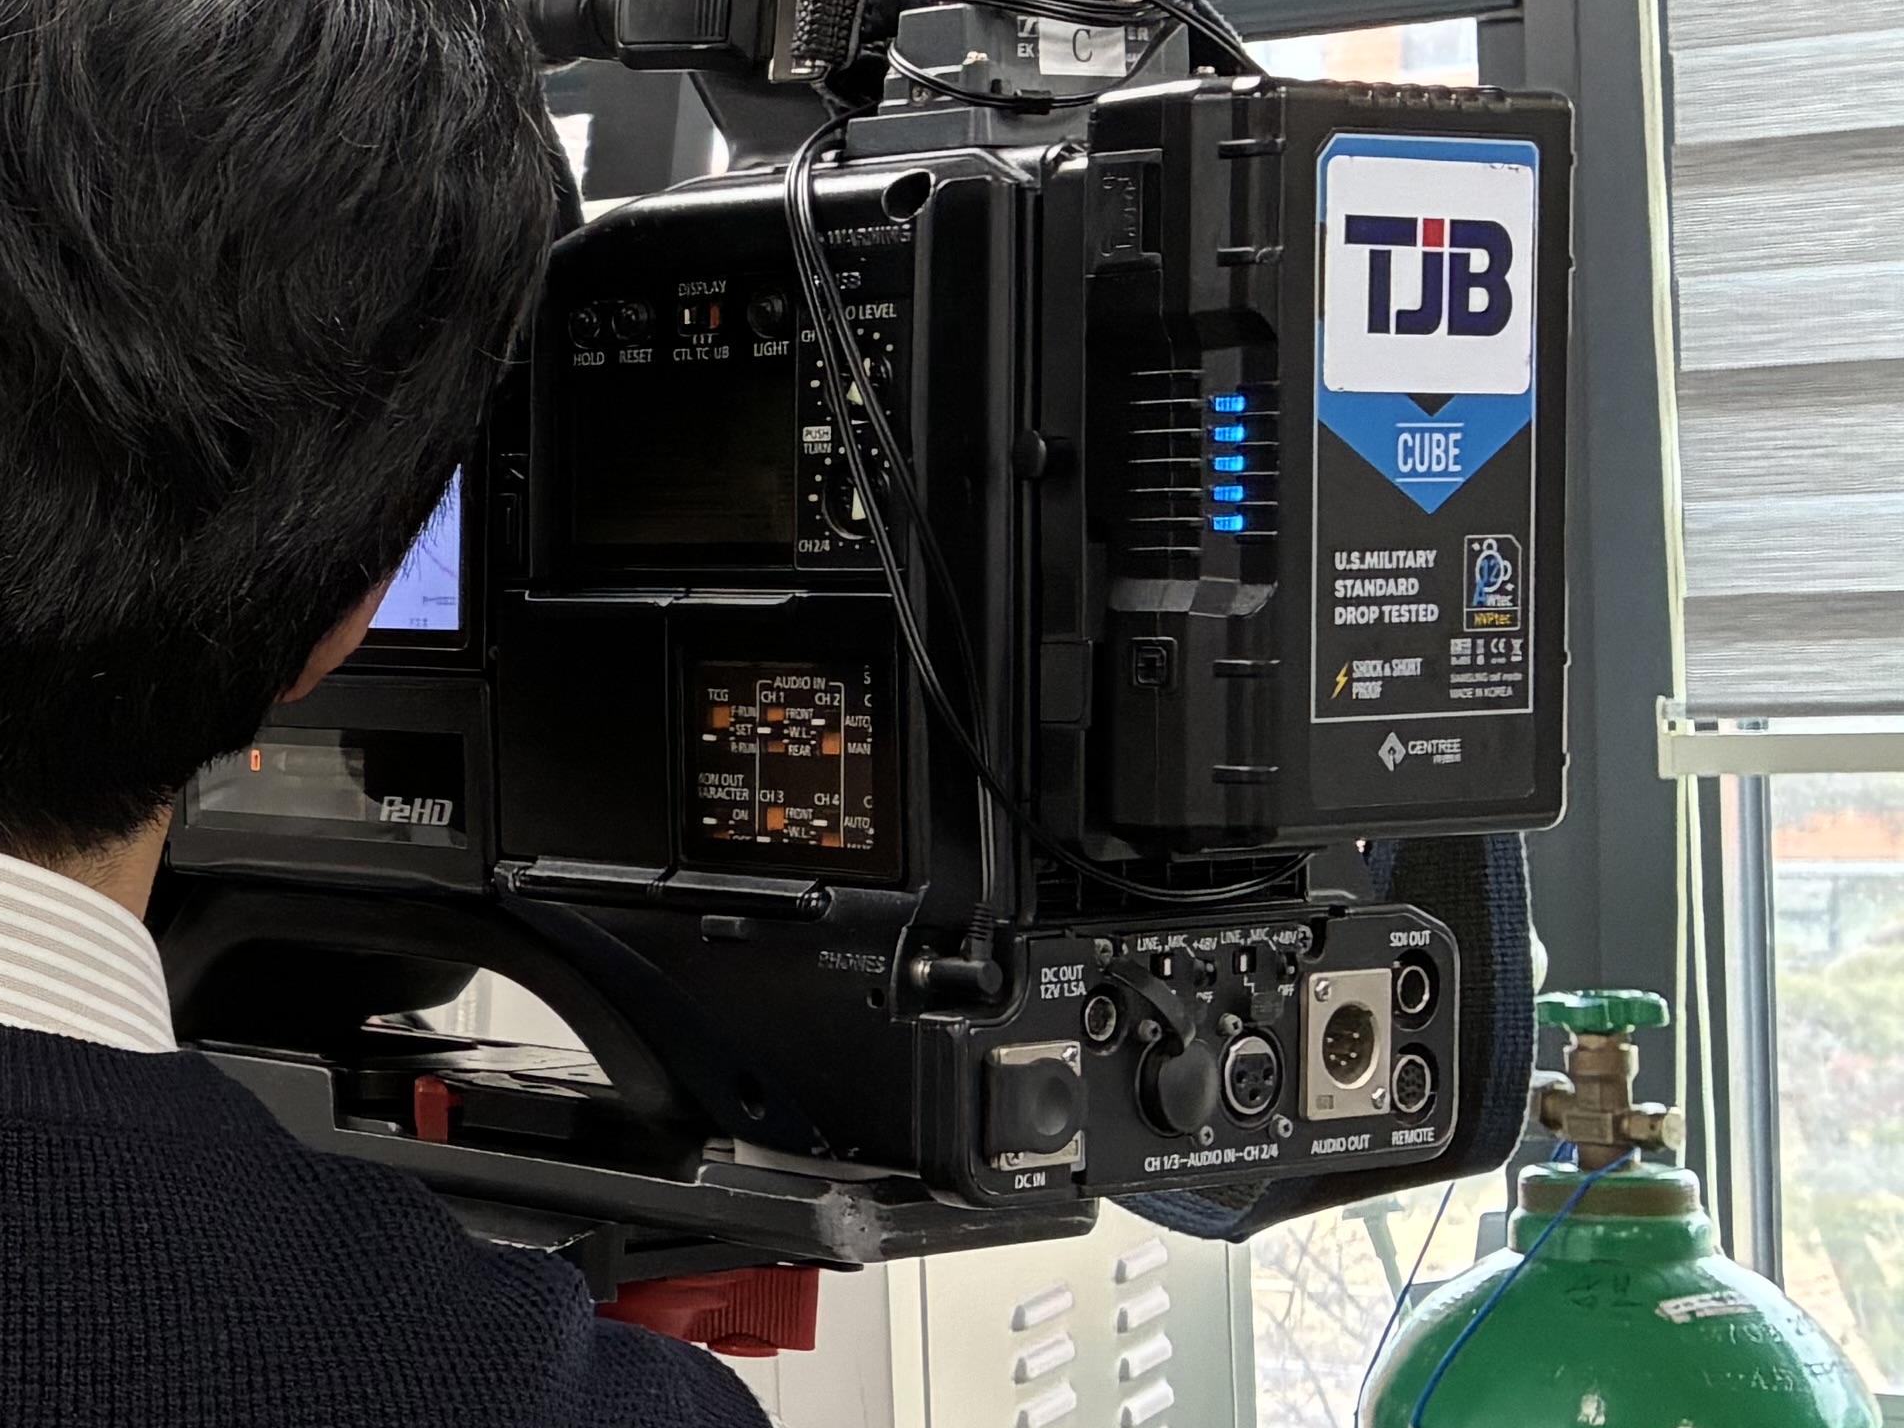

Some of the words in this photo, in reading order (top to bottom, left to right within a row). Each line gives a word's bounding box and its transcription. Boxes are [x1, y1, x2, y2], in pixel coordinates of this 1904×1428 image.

[1072, 28, 1093, 62] C
[1344, 213, 1513, 337] TJB
[678, 280, 727, 297] DISPLAY
[858, 303, 897, 320] LEVEL
[619, 348, 653, 363] RESET
[673, 348, 693, 362] CTL
[696, 347, 710, 361] TC
[714, 345, 730, 360] UB
[753, 341, 790, 357] LIGHT
[573, 352, 605, 366] HOLD
[804, 428, 830, 440] PUSH
[1397, 432, 1463, 473] CUBE
[798, 541, 813, 553] CH
[1334, 549, 1438, 571] U.S.MILITARY
[1334, 578, 1420, 599] STANDARD
[1334, 606, 1380, 625] DROP
[1382, 603, 1440, 624] TESTED
[773, 676, 811, 689] AUDIO
[813, 677, 826, 690] IN
[707, 688, 729, 702] TCG
[760, 691, 776, 704] CH
[778, 691, 785, 703] 1
[1484, 685, 1514, 698] KOREA
[814, 693, 830, 706] CH
[832, 693, 840, 706] 2
[786, 708, 814, 720] FRONT
[844, 715, 871, 727] AUTO
[735, 724, 753, 736] SET
[788, 744, 812, 757] REAR
[721, 774, 745, 787] OUT
[759, 790, 775, 804] CH
[777, 790, 785, 804] 3
[814, 793, 829, 806] CH
[832, 793, 840, 806] 4
[732, 809, 749, 821] ON
[785, 808, 813, 820] FRONT
[844, 816, 871, 829] AUTO
[1390, 931, 1408, 947] SDI
[1409, 930, 1432, 946] OUT
[1041, 967, 1059, 983] DC
[1059, 964, 1084, 981] OUT
[1040, 983, 1061, 999] 12V
[1392, 1128, 1435, 1146] REMOTE
[1311, 1135, 1347, 1155] AUDIO
[1347, 1134, 1372, 1151] OUT
[1144, 1156, 1161, 1172] CH
[1243, 1145, 1260, 1161] CH
[1014, 1174, 1032, 1189] DC
[1032, 1172, 1047, 1188] IN
